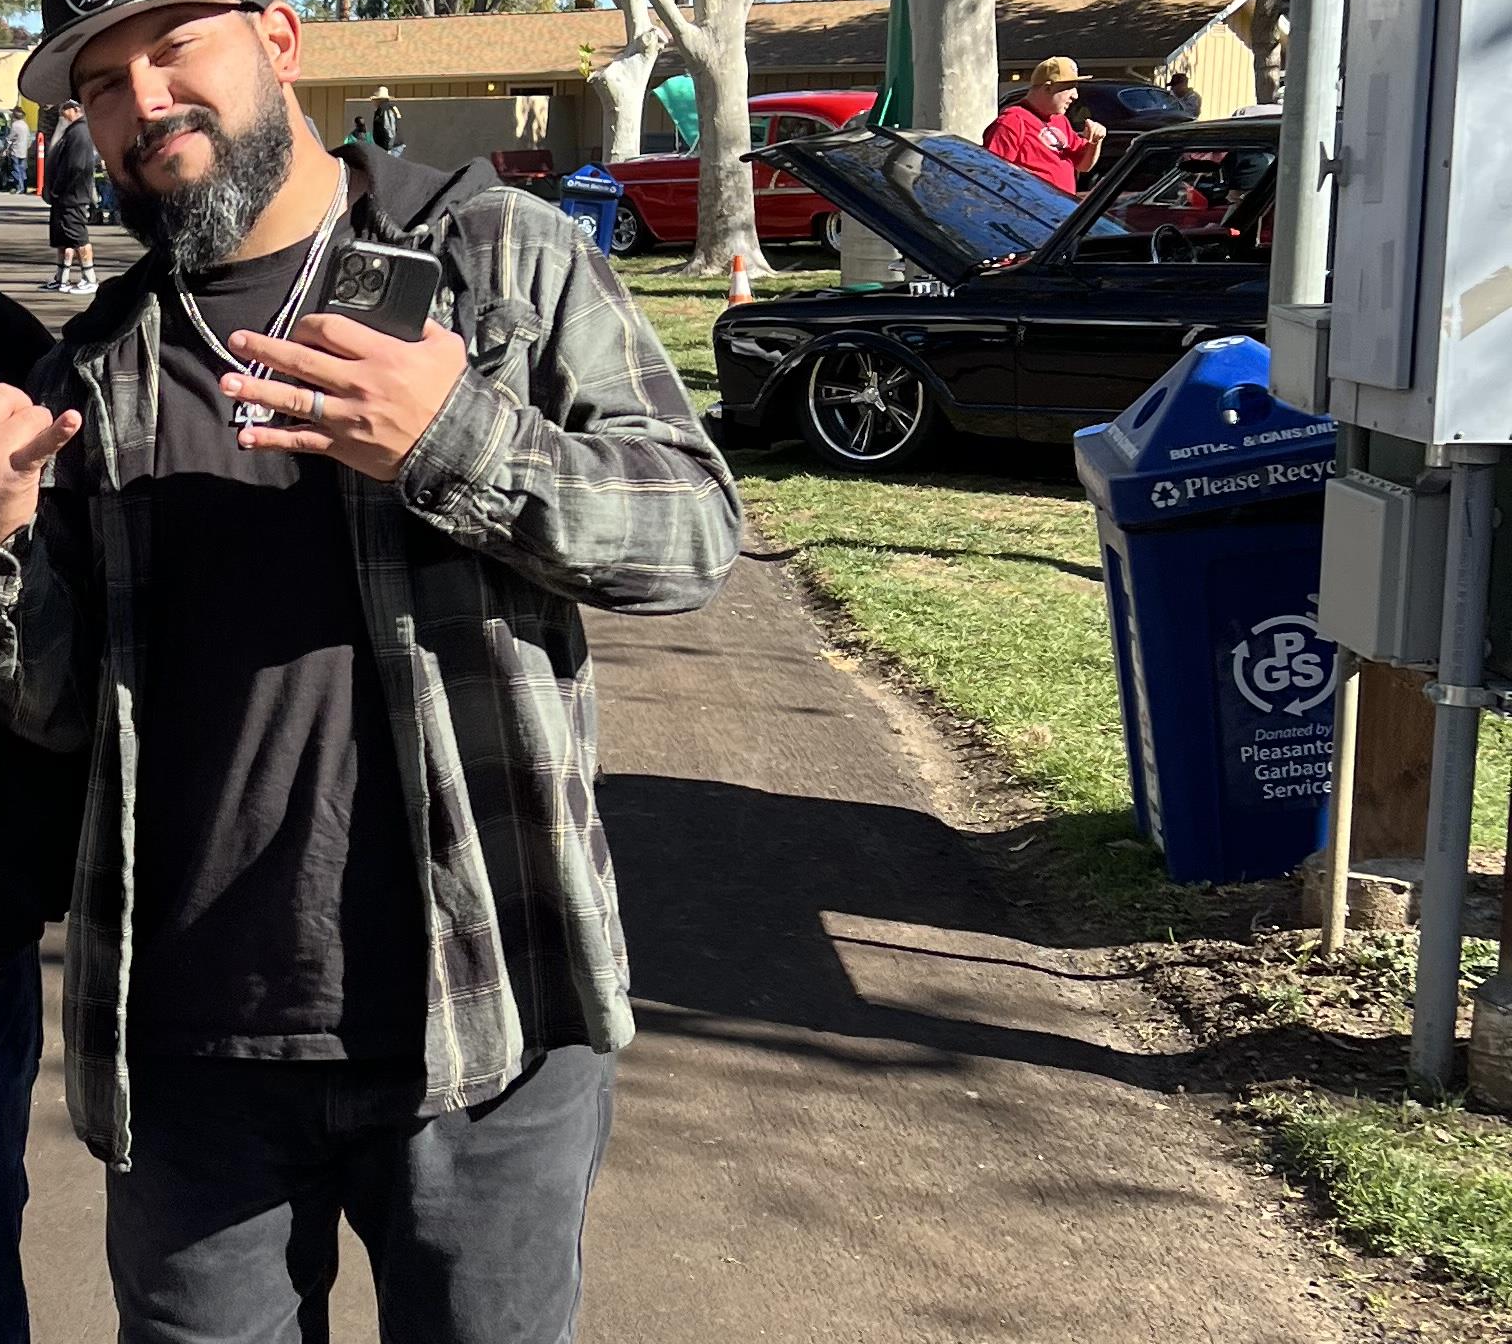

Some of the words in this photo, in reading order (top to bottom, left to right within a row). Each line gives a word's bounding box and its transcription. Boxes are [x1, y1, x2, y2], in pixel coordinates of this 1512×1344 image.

[1243, 435, 1257, 447] &
[1260, 428, 1302, 444] CANS
[1305, 421, 1338, 436] ONL
[1185, 474, 1261, 499] Please
[1255, 723, 1313, 742] Donated
[1316, 723, 1333, 737] by
